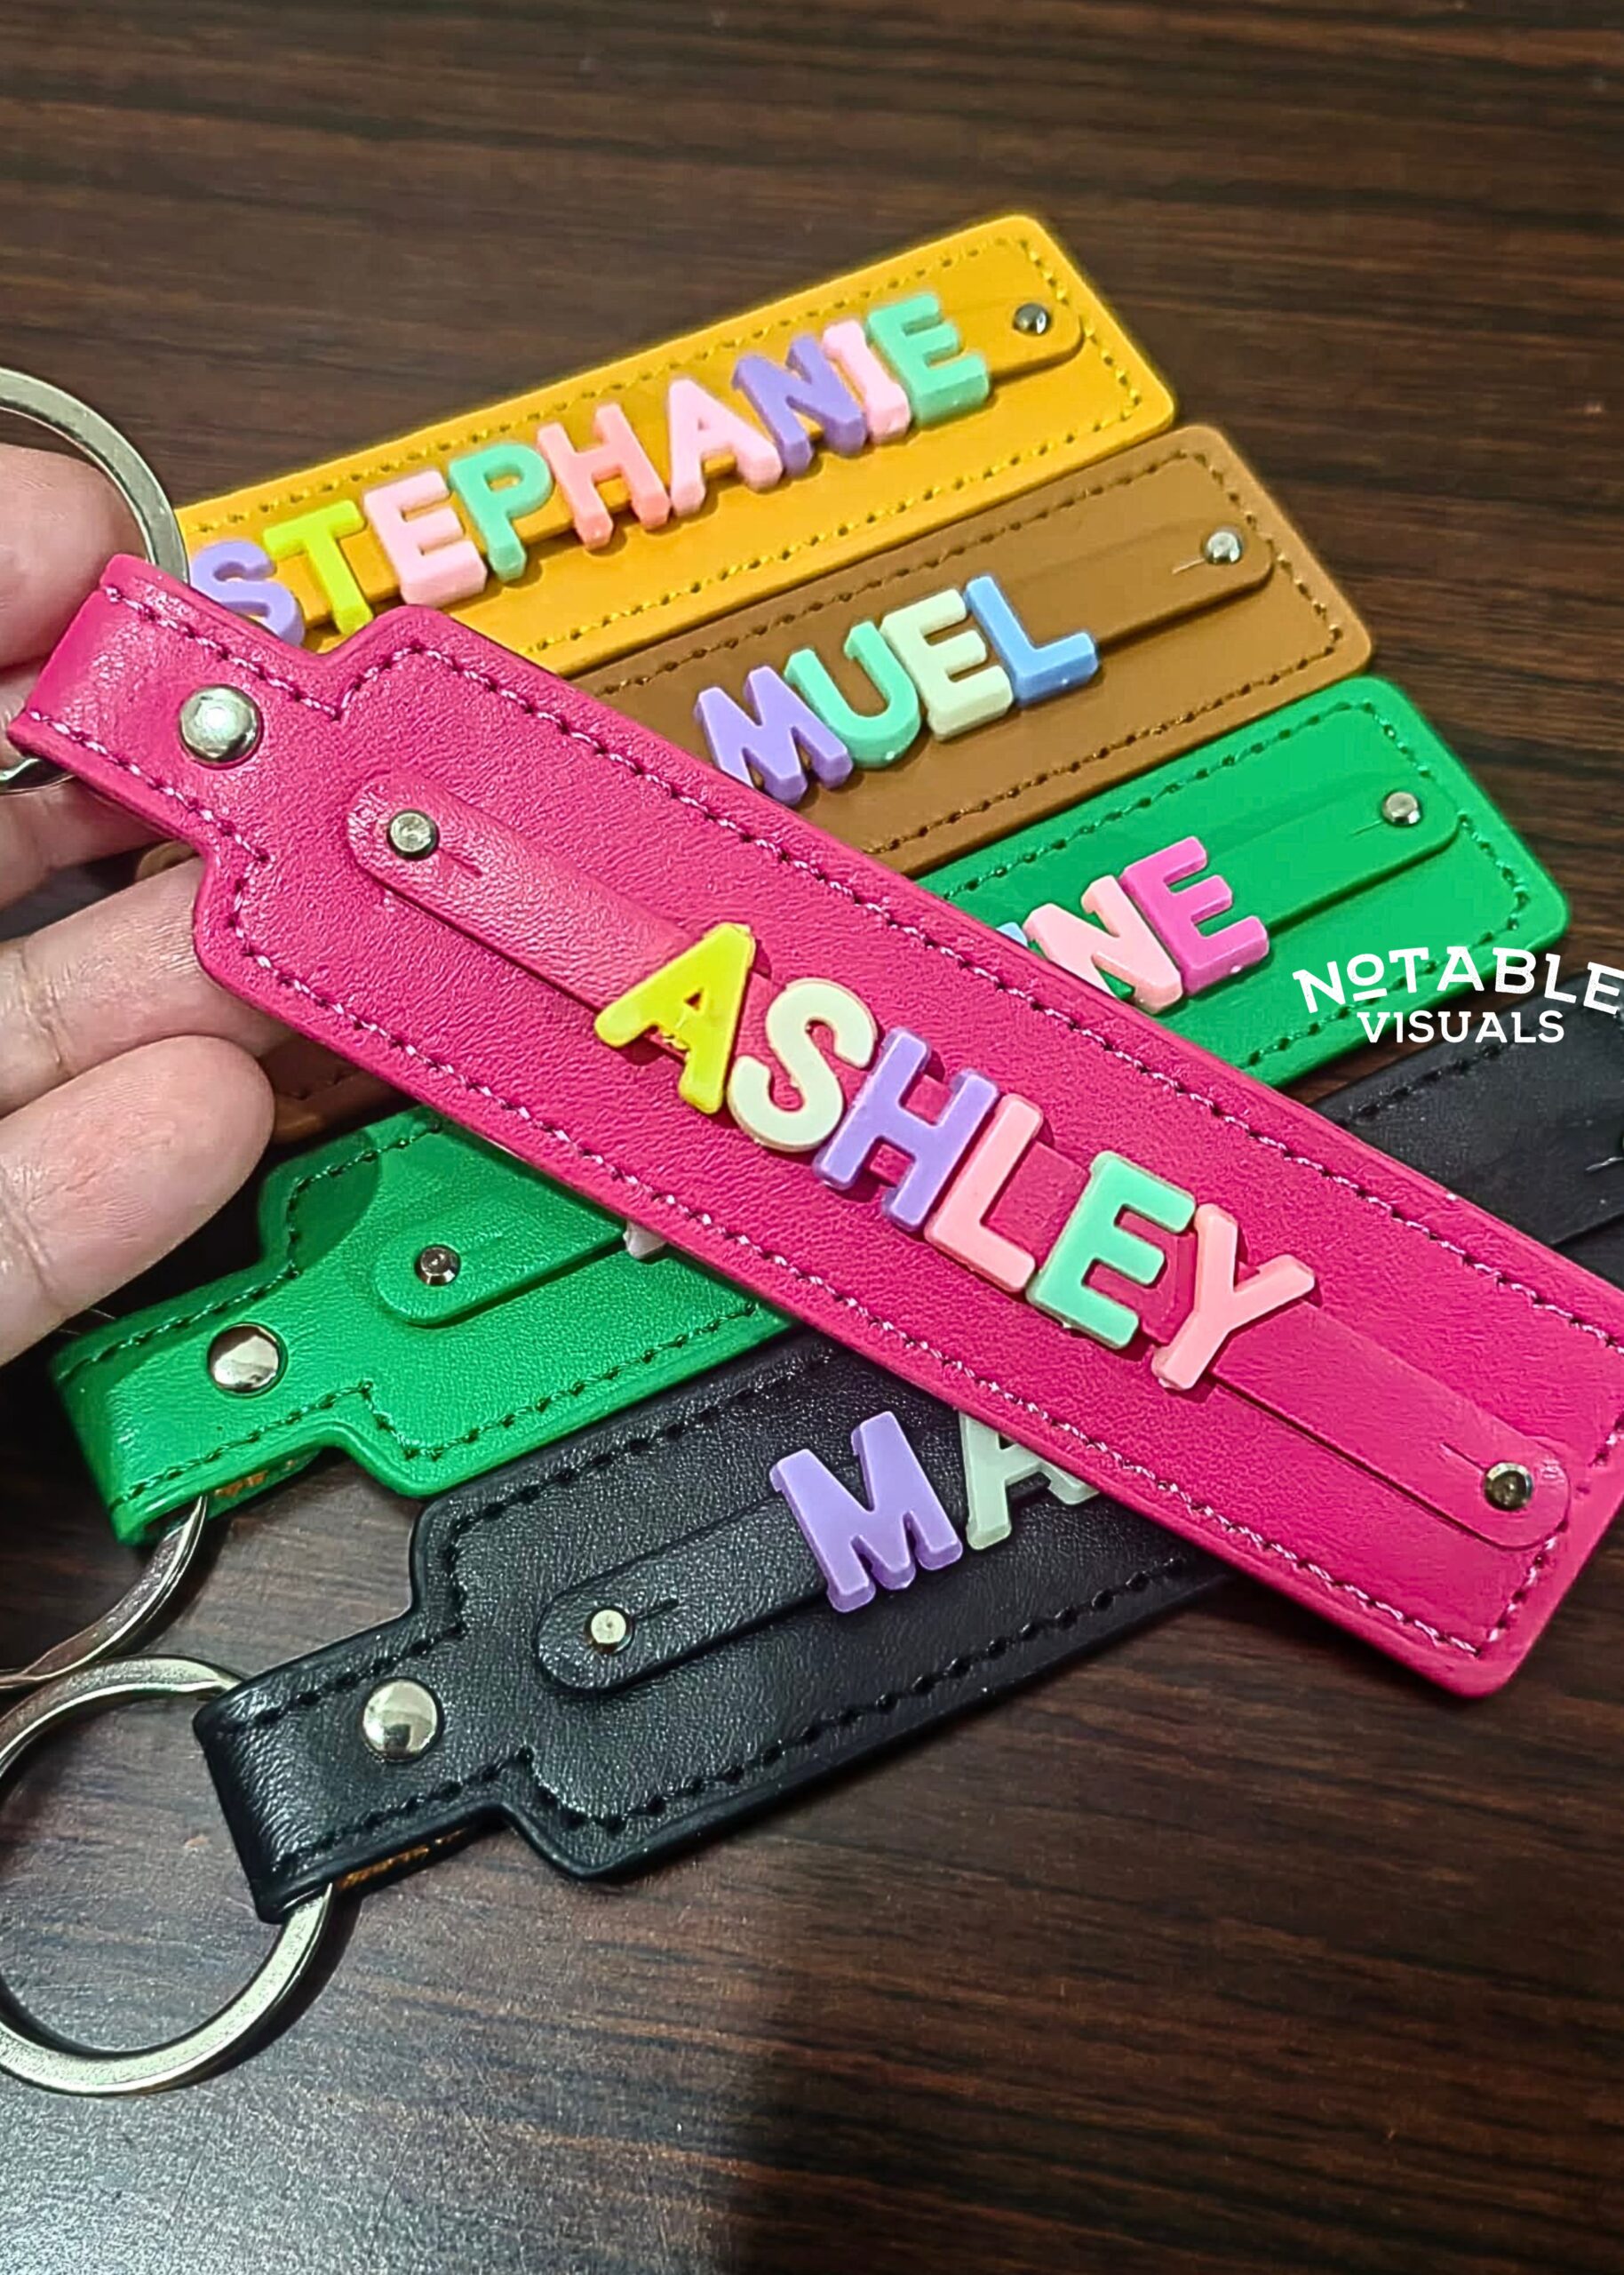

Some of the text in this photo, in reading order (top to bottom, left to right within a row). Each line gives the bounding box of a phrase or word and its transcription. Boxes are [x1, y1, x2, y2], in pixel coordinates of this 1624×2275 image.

[188, 291, 991, 648] STEPHANIE
[694, 575, 1099, 807] MUEL
[996, 835, 1270, 1014] NE
[593, 922, 1317, 1391] ASHLEY
